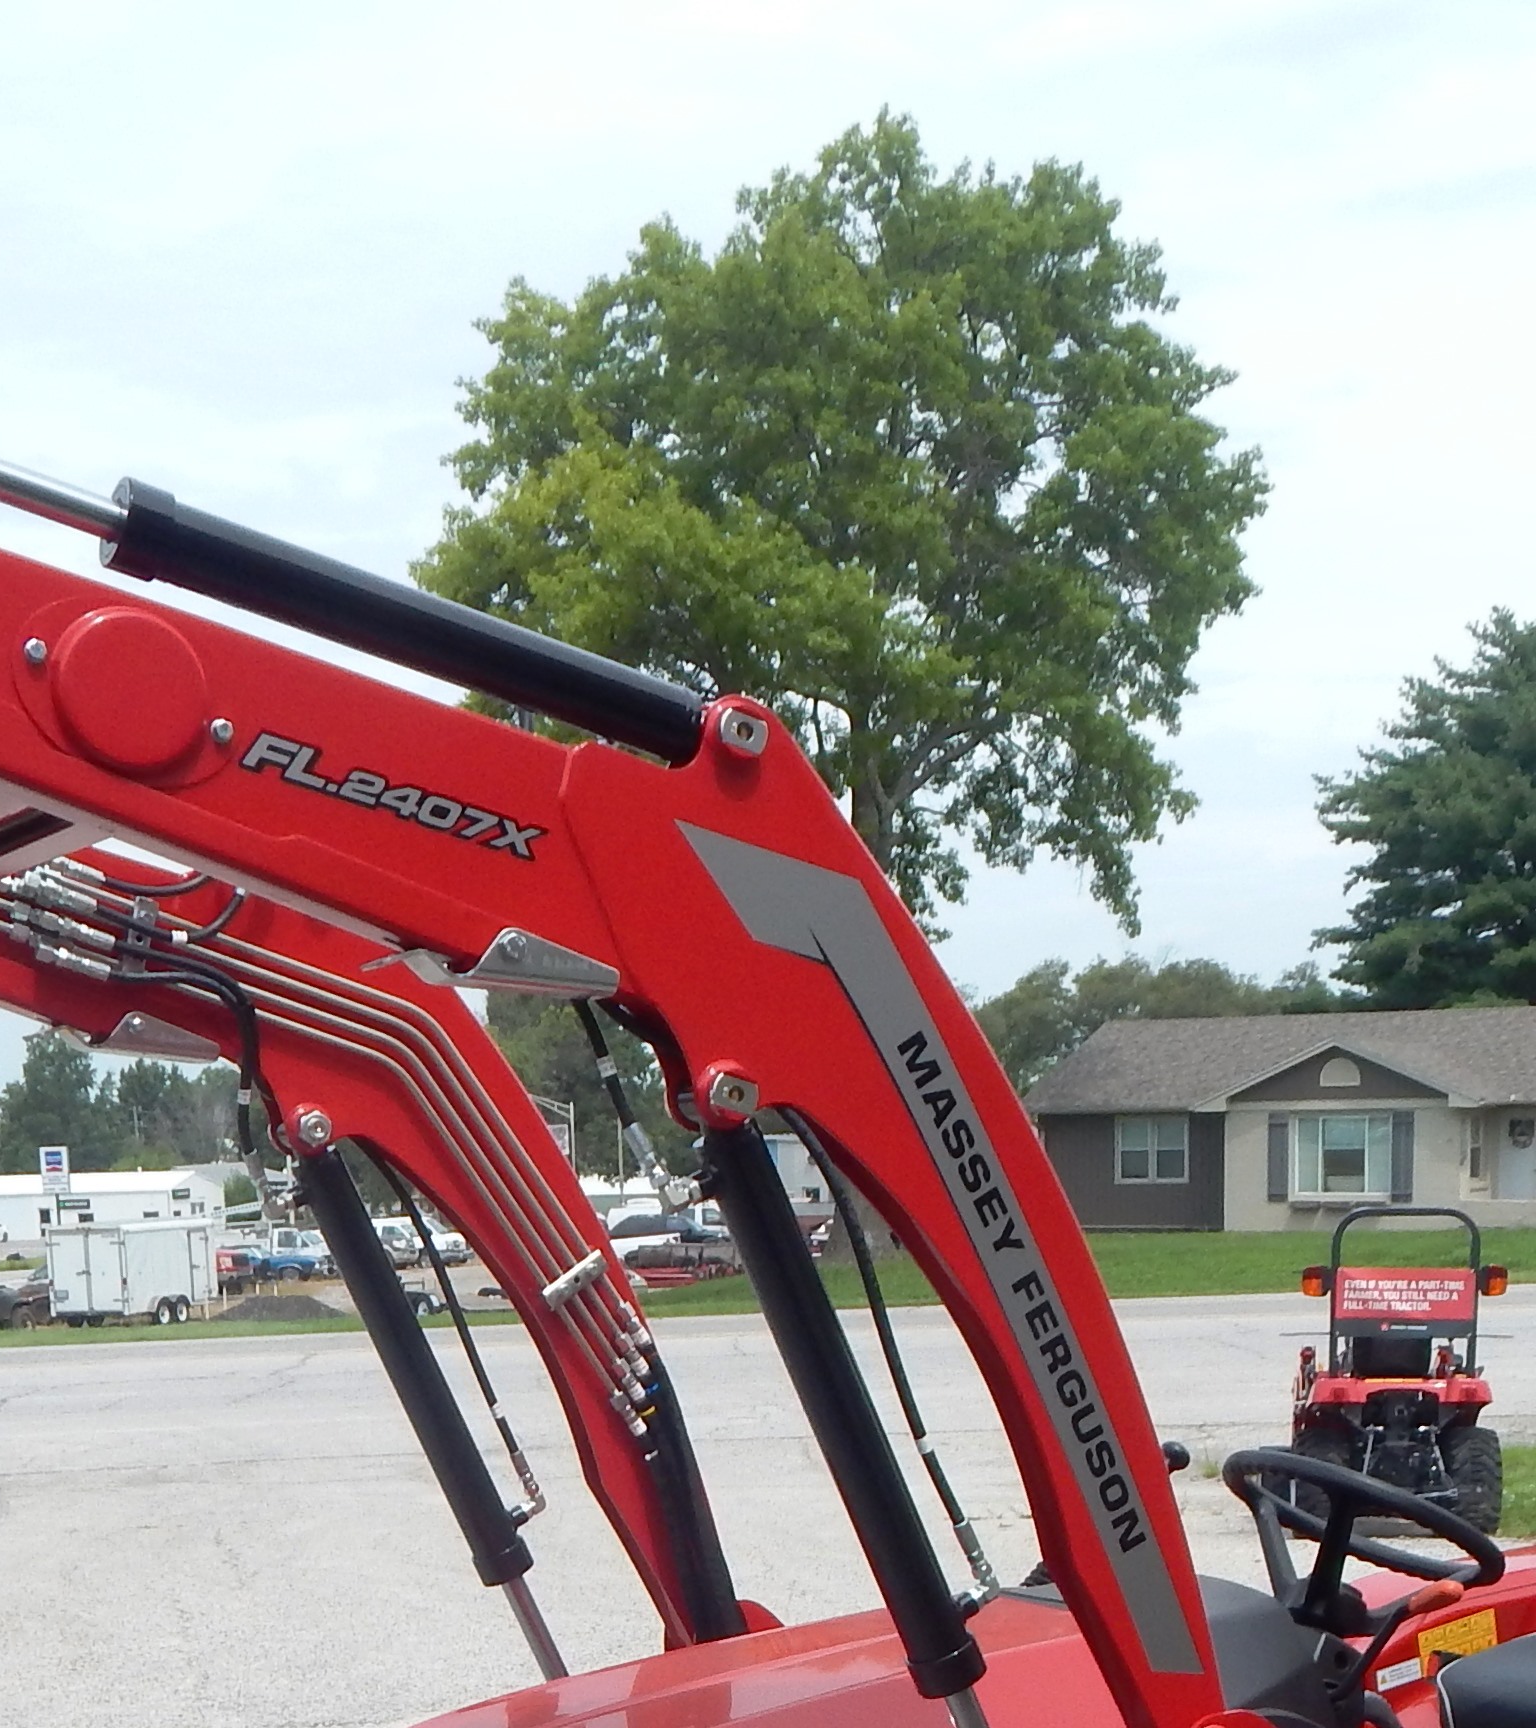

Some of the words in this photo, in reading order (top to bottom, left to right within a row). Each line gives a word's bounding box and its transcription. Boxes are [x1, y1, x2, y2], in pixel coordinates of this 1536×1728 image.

[241, 731, 546, 859] FL.2407X
[1344, 1279, 1366, 1289] EVEN
[1368, 1280, 1376, 1289] IF
[1378, 1279, 1408, 1289] YOU'RE
[1410, 1280, 1417, 1289] A
[1418, 1280, 1465, 1290] PART-TIME
[897, 1031, 1025, 1254] MASSEY
[1012, 1271, 1147, 1554] FERGUSON
[1344, 1290, 1381, 1300] FARMER,
[1383, 1290, 1400, 1300] YOU
[1401, 1291, 1425, 1300] STILL
[1427, 1291, 1450, 1300] NEED
[1451, 1291, 1459, 1300] A
[1343, 1301, 1389, 1310] FULL-TIME
[1390, 1301, 1432, 1311] TRACTOR.
